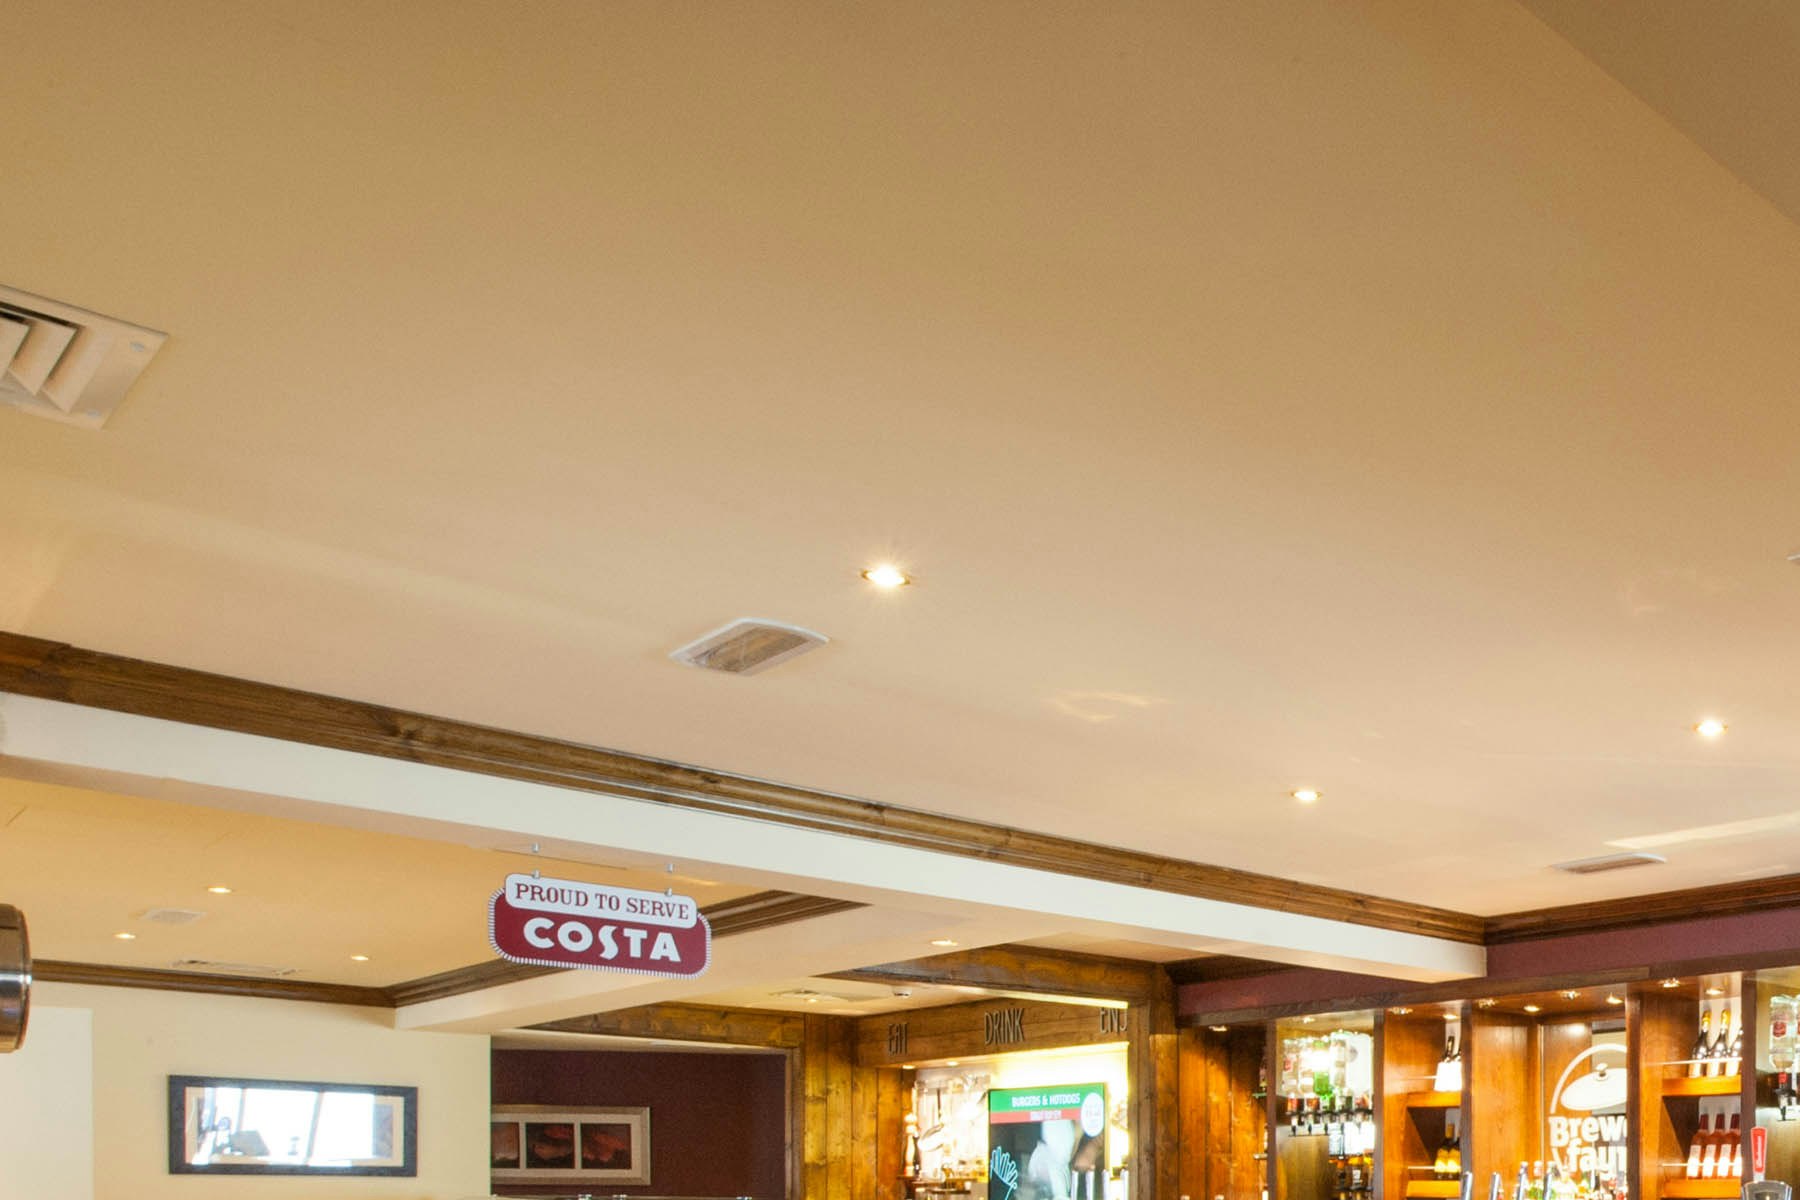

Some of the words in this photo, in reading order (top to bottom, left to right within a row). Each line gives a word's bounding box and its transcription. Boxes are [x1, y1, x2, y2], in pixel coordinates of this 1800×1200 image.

[515, 882, 588, 907] PROUD
[595, 893, 620, 911] TO
[626, 898, 689, 920] SERVE
[523, 917, 681, 962] COSTA
[984, 1008, 1025, 1046] DRINK
